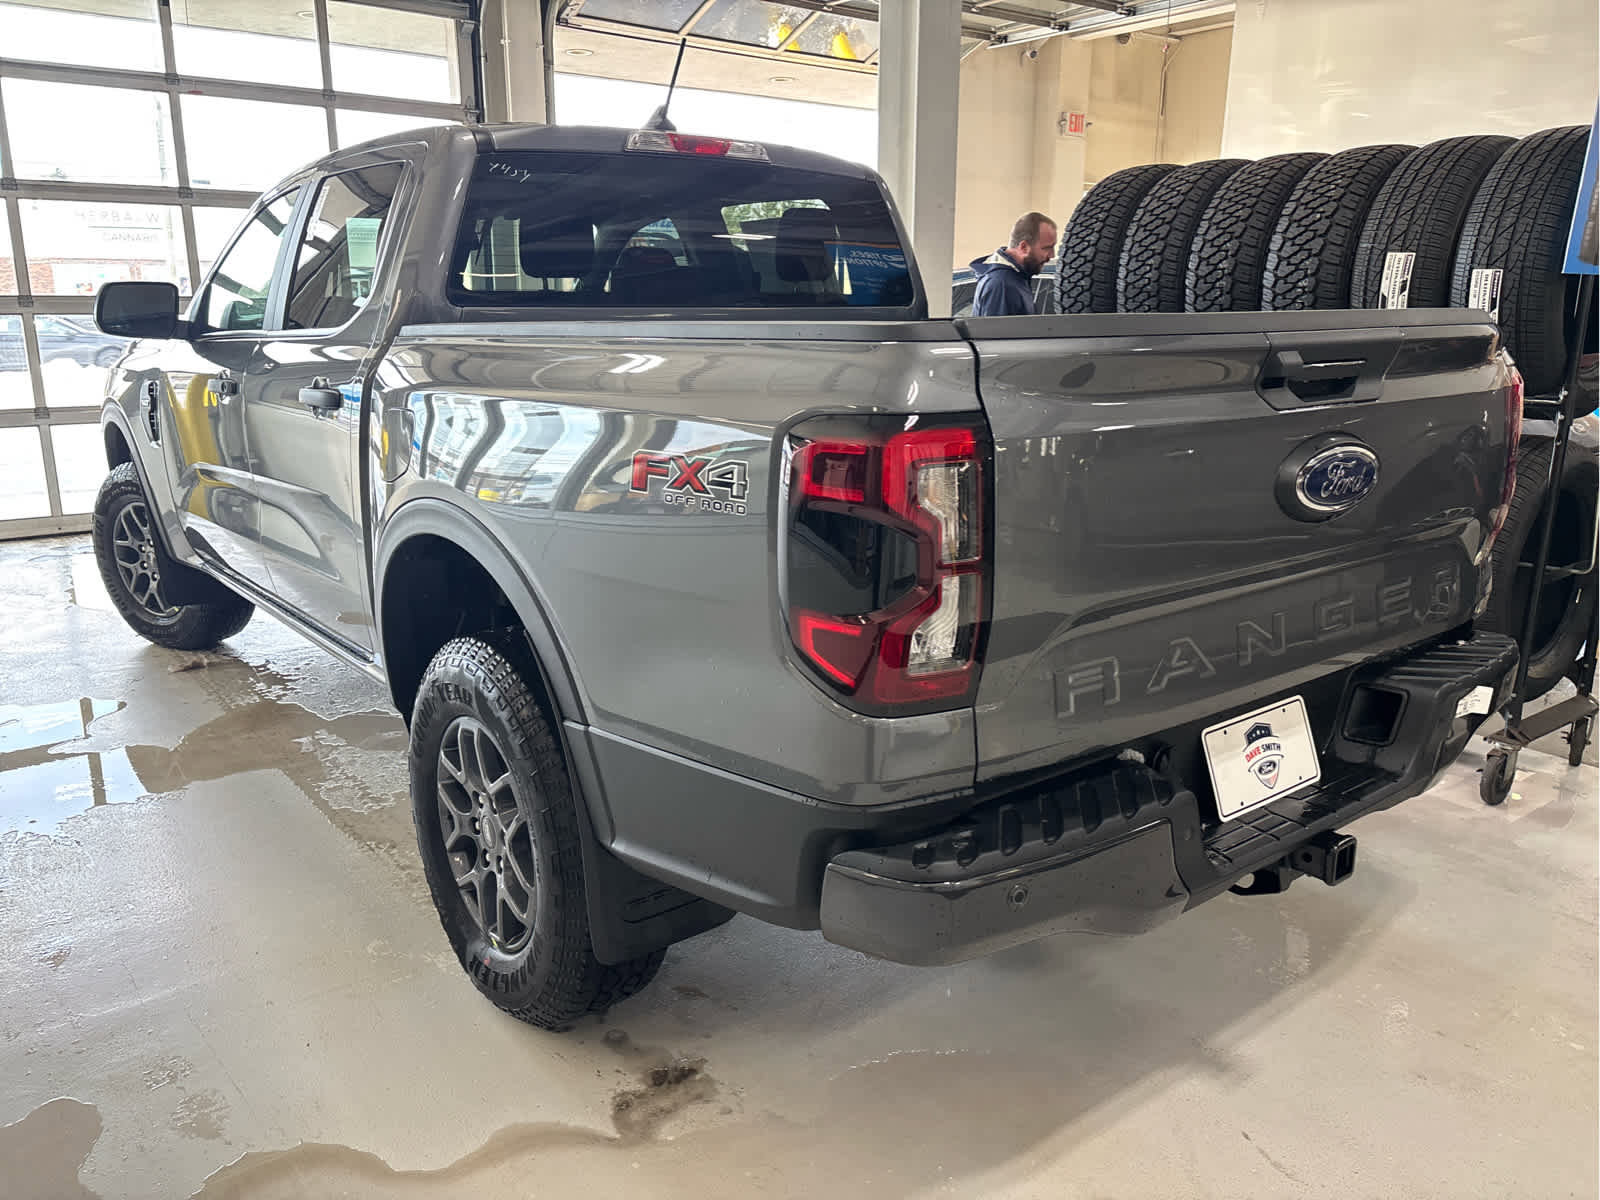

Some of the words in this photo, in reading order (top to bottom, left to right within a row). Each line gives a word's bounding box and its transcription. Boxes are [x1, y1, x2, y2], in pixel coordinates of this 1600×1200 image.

[1068, 112, 1085, 134] EXIT
[629, 449, 749, 502] FX4
[1320, 459, 1368, 498] Ford
[664, 492, 697, 508] OFF
[700, 497, 748, 516] ROAD
[1053, 562, 1461, 720] RANGER
[1245, 746, 1262, 763] DAVE
[1261, 742, 1281, 753] SMITH
